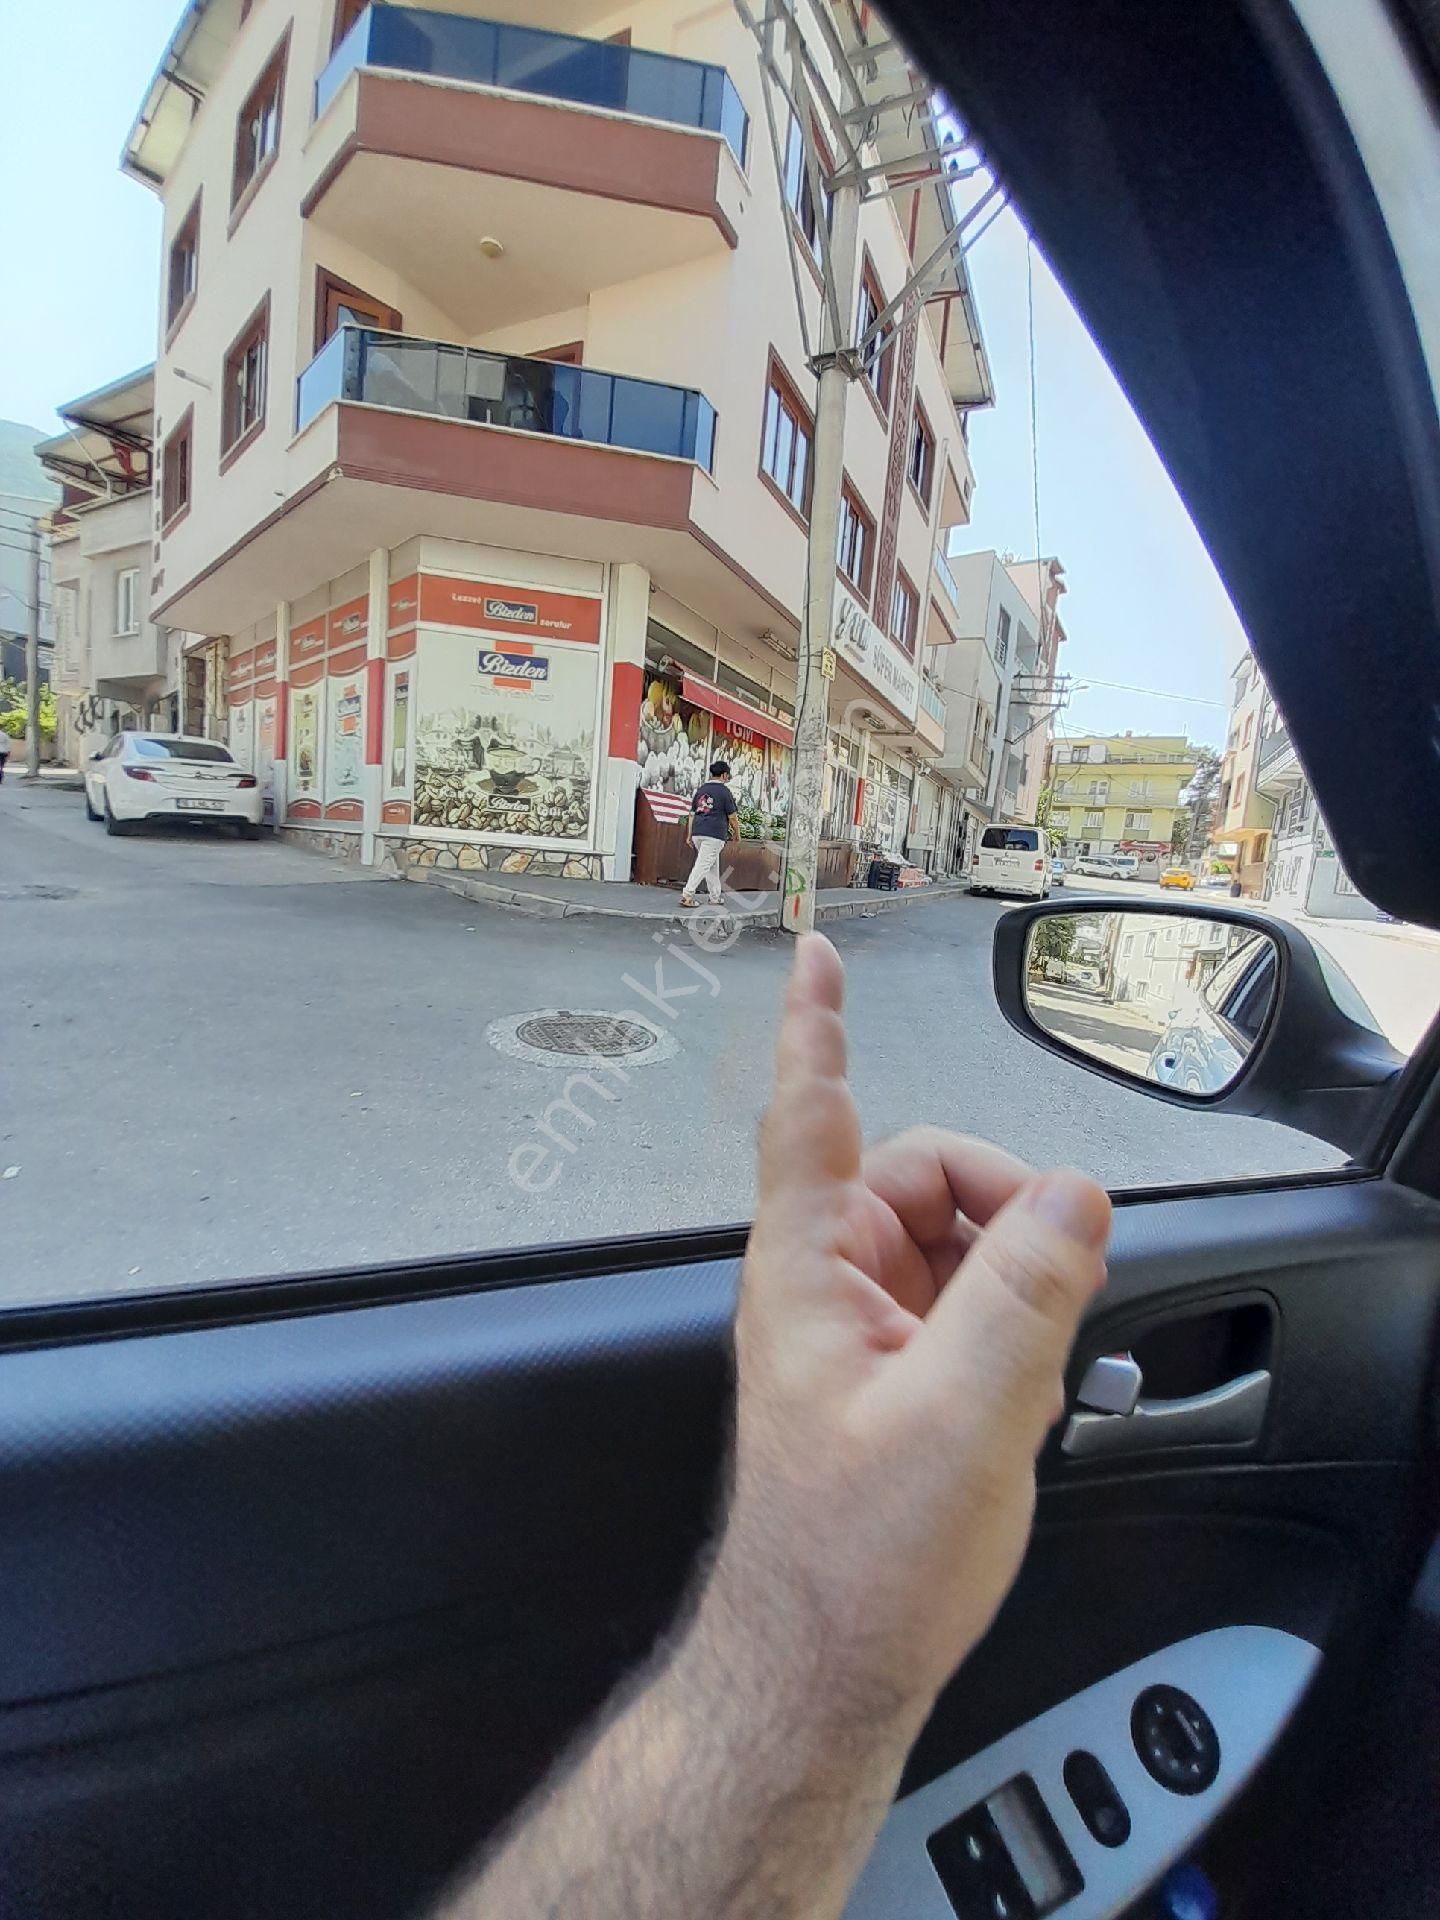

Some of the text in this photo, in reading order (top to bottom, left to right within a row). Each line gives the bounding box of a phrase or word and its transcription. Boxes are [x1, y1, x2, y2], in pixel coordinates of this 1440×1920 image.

[486, 600, 535, 621] Bizden
[479, 652, 547, 680] Bizden
[490, 796, 530, 812] Bizden
